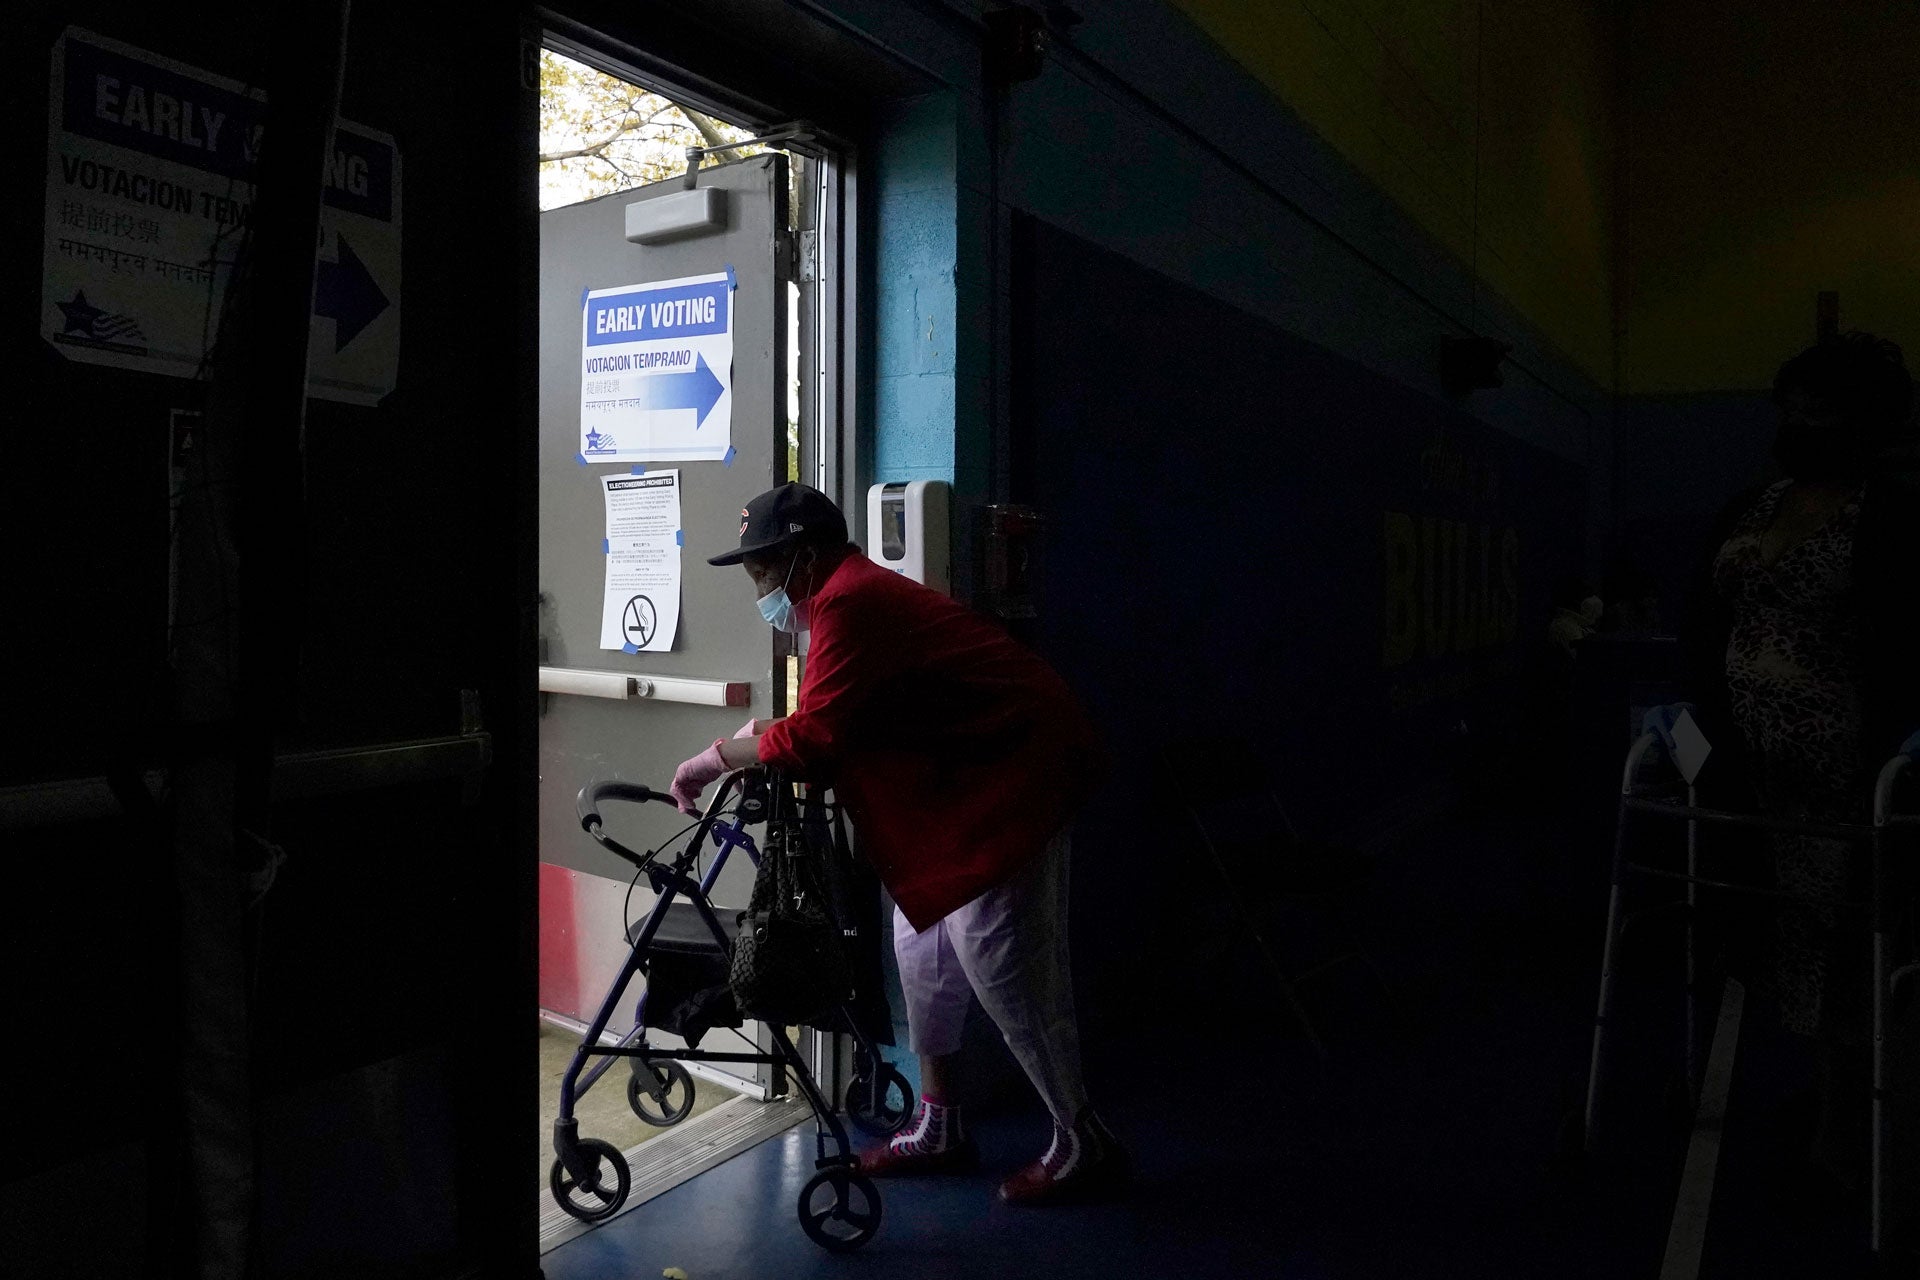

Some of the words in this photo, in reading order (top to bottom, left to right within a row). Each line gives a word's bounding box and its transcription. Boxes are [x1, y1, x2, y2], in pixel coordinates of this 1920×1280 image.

[95, 73, 226, 151] EARLY
[61, 154, 193, 214] VOTACION
[596, 304, 647, 335] EARLY
[650, 296, 716, 328] VOTING
[586, 354, 631, 374] VOTACION
[633, 350, 691, 369] TEMPRANO
[1382, 508, 1520, 668] BULLS
